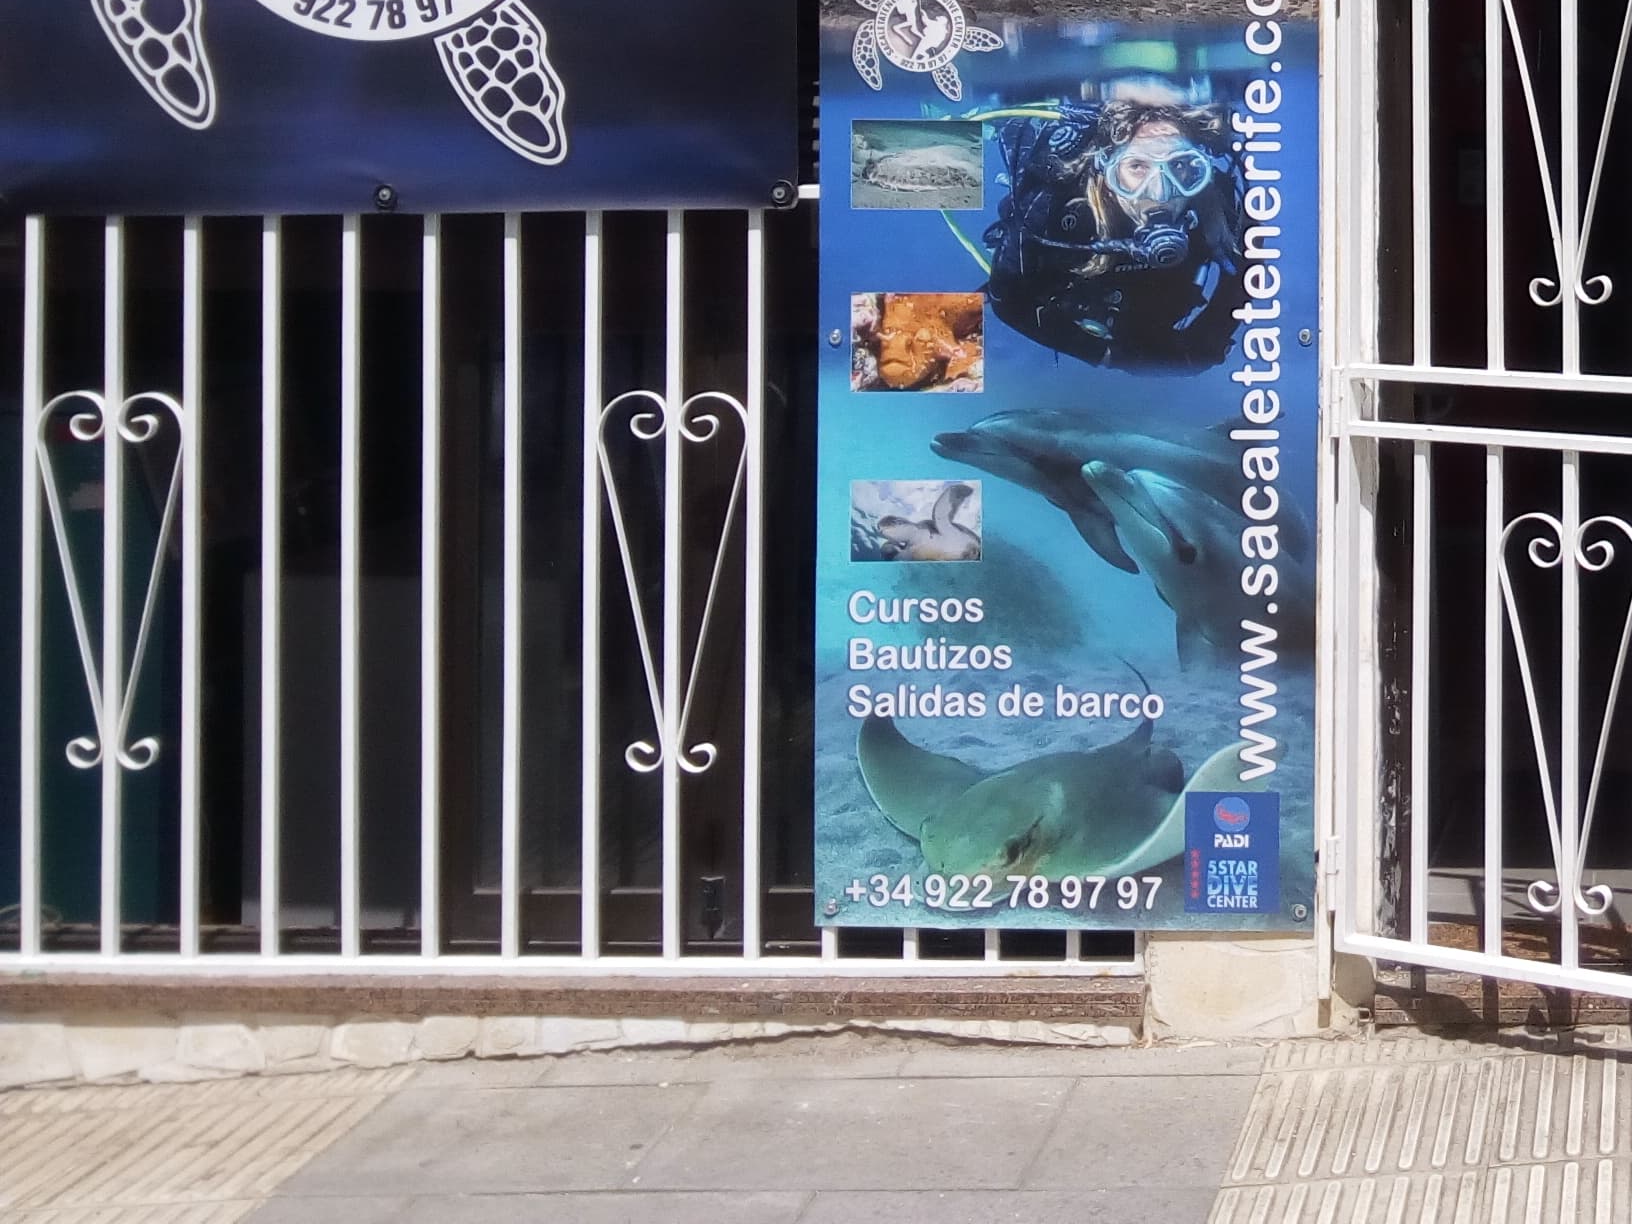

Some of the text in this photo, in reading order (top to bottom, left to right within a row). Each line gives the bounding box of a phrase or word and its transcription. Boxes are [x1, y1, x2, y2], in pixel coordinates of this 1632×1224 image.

[848, 590, 984, 623] Cursos
[849, 637, 1012, 670] Bautizos
[848, 684, 1164, 719] Salidas de barco
[1214, 834, 1249, 848] PADI
[845, 875, 1163, 910] +34 922 78 97 97
[1207, 875, 1258, 895] DIVE
[1207, 895, 1258, 908] CENTER
